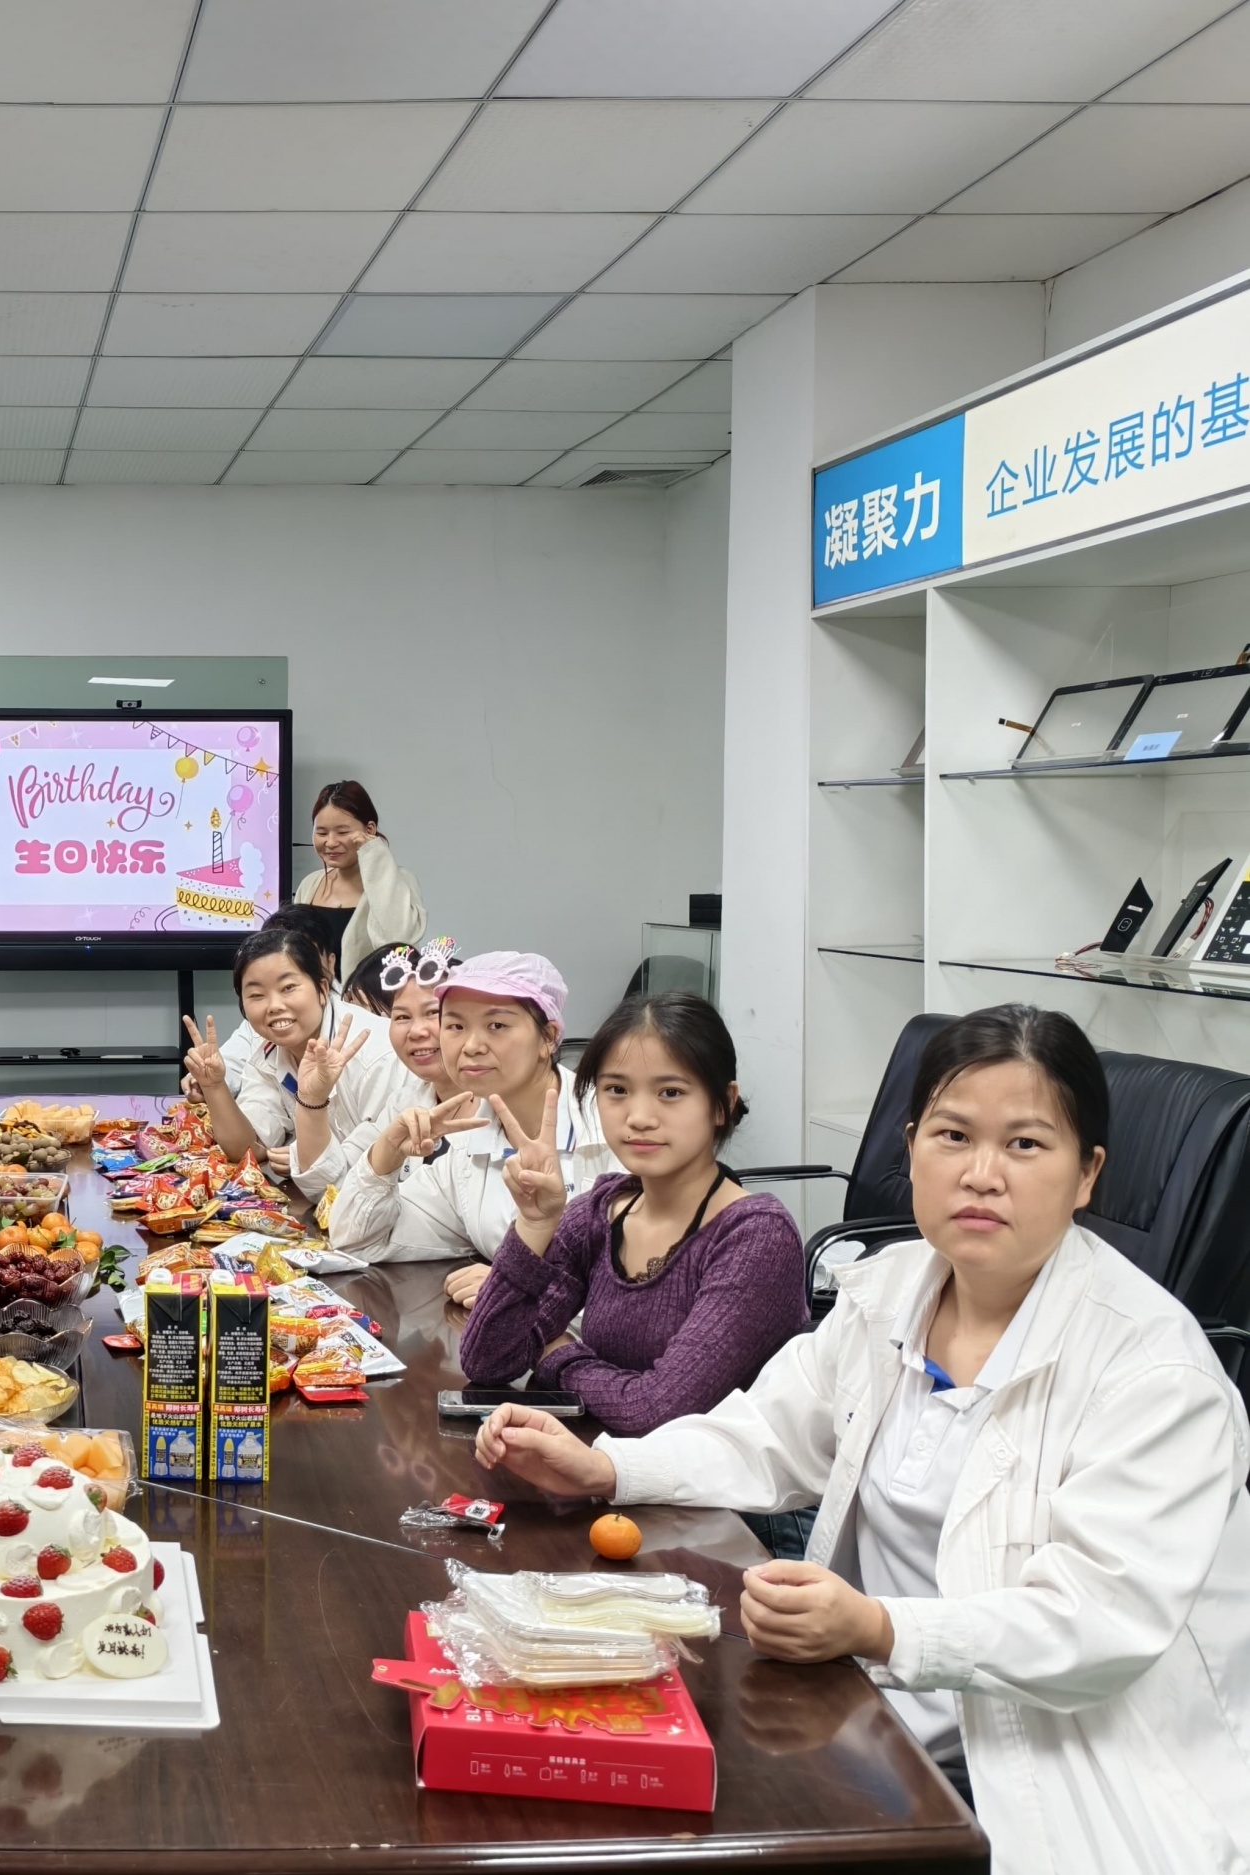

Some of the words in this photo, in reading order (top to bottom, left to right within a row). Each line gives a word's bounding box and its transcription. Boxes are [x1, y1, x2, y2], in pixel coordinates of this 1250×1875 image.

[985, 372, 1250, 519] 企业发展的基
[823, 471, 942, 570] 凝聚力
[8, 762, 176, 833] Birthday
[14, 839, 167, 874] 生日快乐
